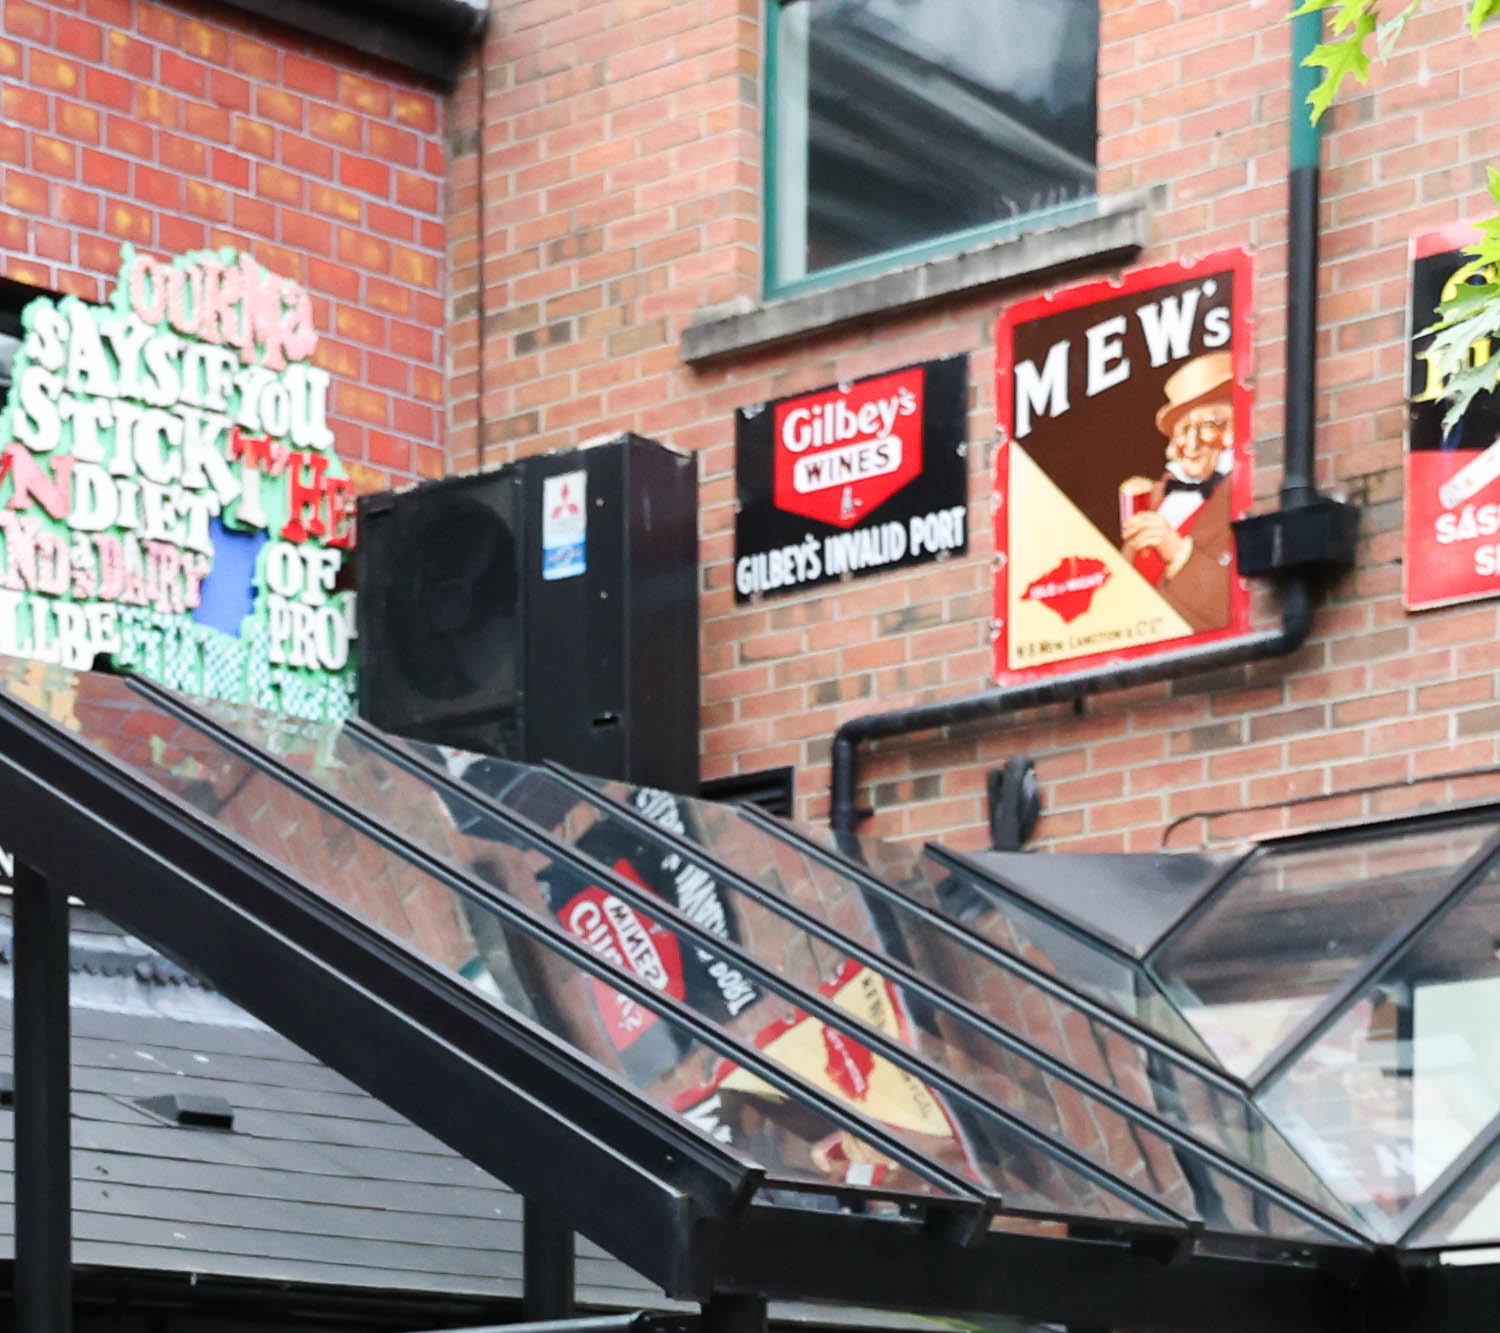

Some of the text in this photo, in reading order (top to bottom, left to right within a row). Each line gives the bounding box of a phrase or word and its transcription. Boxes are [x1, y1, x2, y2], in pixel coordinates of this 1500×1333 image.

[26, 300, 183, 406] SAYS
[235, 363, 335, 448] YOU
[782, 386, 917, 453] Gilbey's
[13, 366, 242, 506] STICK
[804, 443, 889, 484] WINES
[68, 463, 221, 557] DIET
[736, 506, 967, 595] GILBEY'S INVALID PORT
